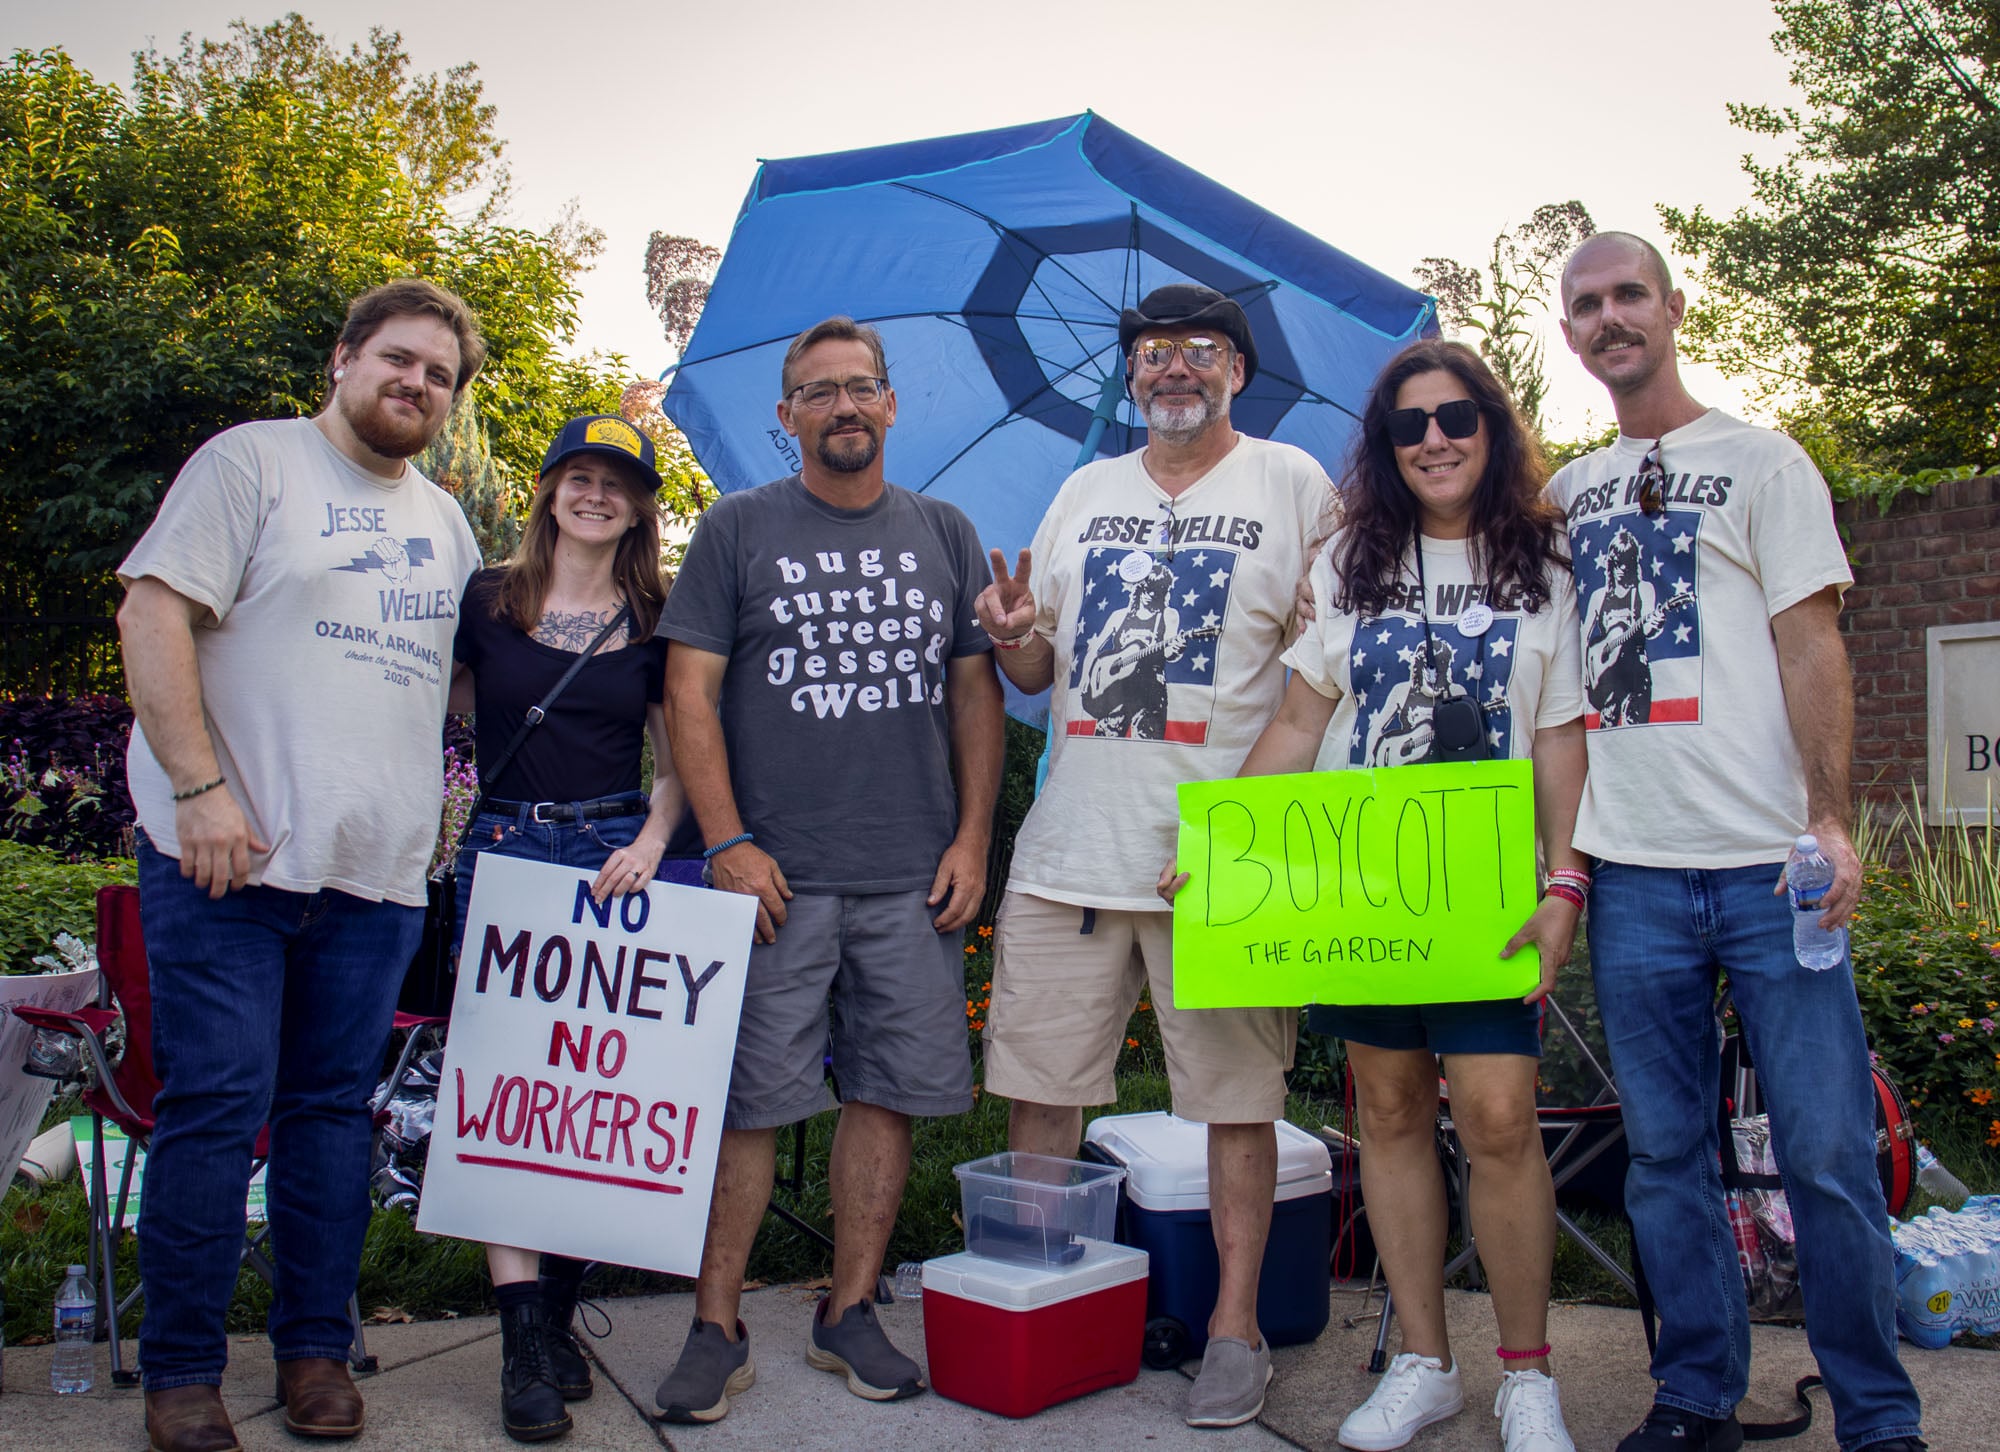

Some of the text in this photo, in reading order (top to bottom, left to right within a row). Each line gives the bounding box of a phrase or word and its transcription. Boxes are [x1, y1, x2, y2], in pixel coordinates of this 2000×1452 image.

[1624, 473, 1733, 507] WLLES
[320, 502, 387, 537] JESSE
[1078, 515, 1264, 551] JESSE WELLES
[776, 548, 918, 584] bugs
[379, 588, 457, 623] WELLES
[769, 578, 944, 624] turtles
[315, 620, 443, 674] OZARK, ARKANS
[798, 615, 922, 650] trees
[383, 669, 411, 687] 2026
[767, 647, 917, 686] Jesse
[791, 672, 943, 719] Wells
[1965, 734, 2000, 773] B
[1207, 785, 1519, 928] BOYCOTT
[572, 879, 651, 933] NO
[1244, 937, 1433, 965] THE GARDEN
[475, 924, 726, 1025] MONEY
[547, 1021, 627, 1079] NO
[455, 1067, 699, 1175] WORKERS!
